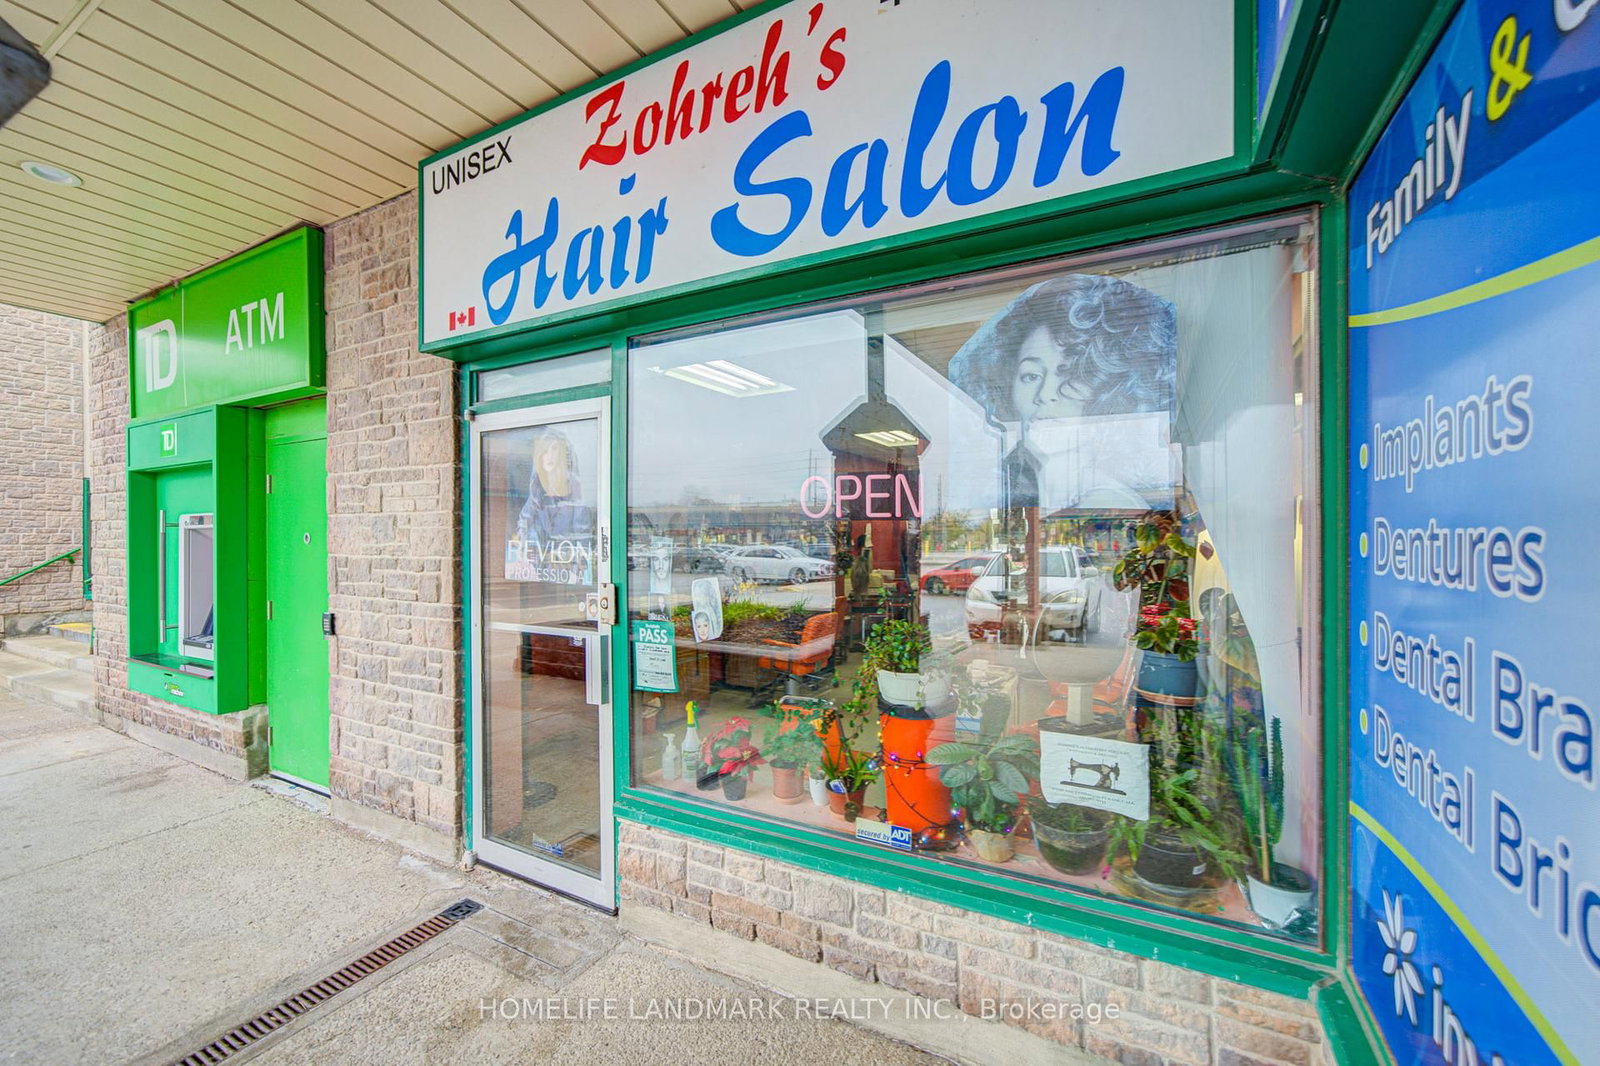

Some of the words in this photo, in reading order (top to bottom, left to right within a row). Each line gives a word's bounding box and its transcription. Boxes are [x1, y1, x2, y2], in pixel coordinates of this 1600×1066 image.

[579, 2, 847, 171] Zohreh's
[431, 136, 513, 195] UNISEX
[1366, 88, 1473, 270] Family
[1487, 15, 1533, 121] &
[482, 173, 670, 326] Hair
[710, 59, 1125, 258] Salon
[137, 319, 178, 393] TD
[225, 292, 285, 355] ATM
[161, 430, 175, 451] TD
[1374, 375, 1533, 493] Implants
[800, 473, 924, 519] OPEN
[508, 539, 592, 564] REVLON
[1374, 517, 1546, 603] Dentures
[639, 627, 668, 644] PASS
[1374, 611, 1475, 722] Dental
[1374, 704, 1475, 854] Dental
[892, 829, 911, 842] ADT
